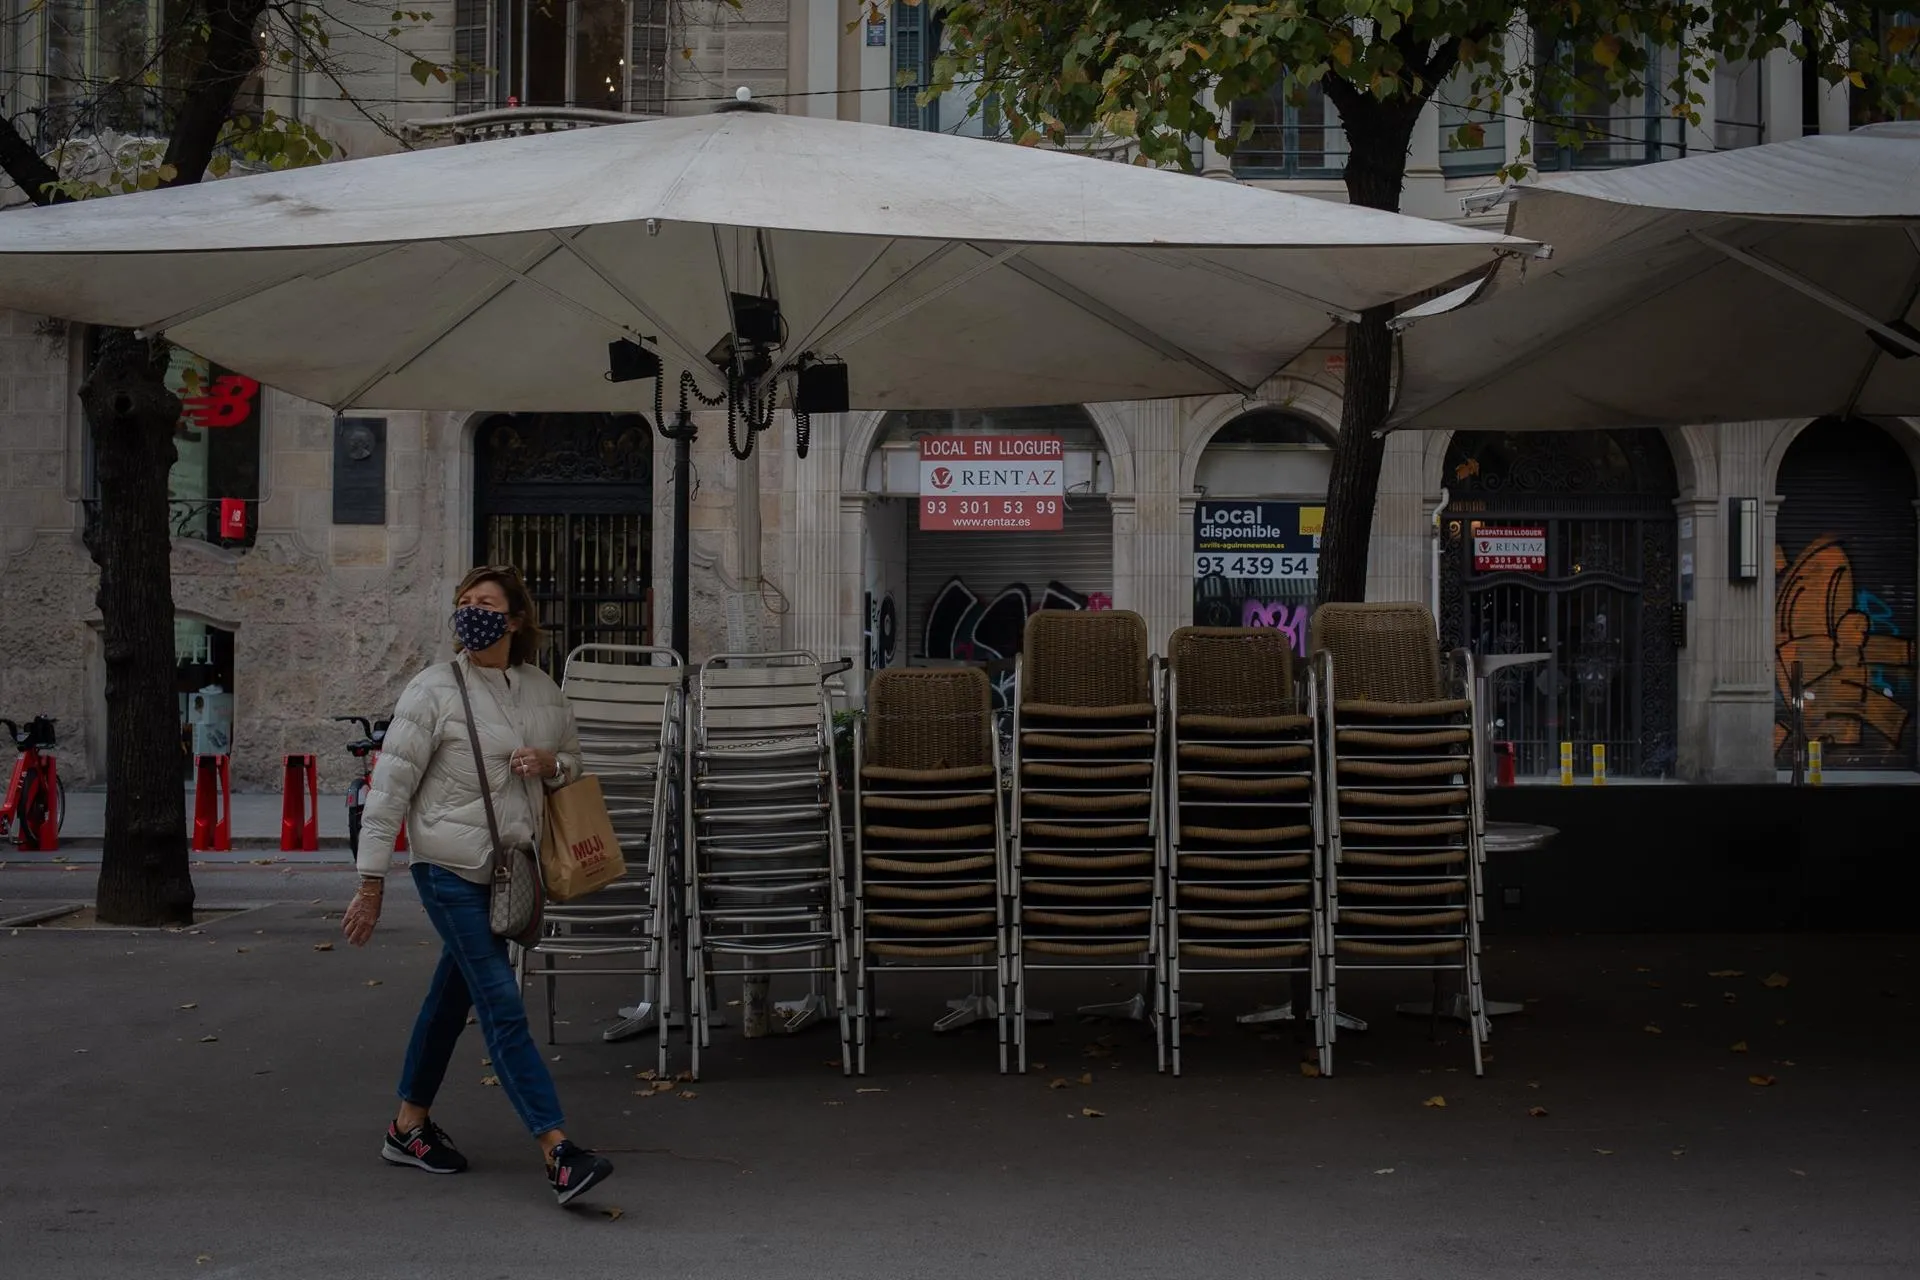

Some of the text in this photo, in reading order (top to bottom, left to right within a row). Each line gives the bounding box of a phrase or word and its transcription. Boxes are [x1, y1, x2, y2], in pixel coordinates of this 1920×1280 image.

[924, 440, 1060, 456] LOCAL EN LLOGUER
[962, 470, 1056, 486] RENTAZ
[927, 501, 1056, 514] 93 301 53 99
[1201, 505, 1263, 524] Local
[953, 517, 1031, 527] www.rentaz.es
[1200, 525, 1281, 540] disponible
[1495, 543, 1543, 552] RENTAZ
[1197, 557, 1309, 575] 93 439 54
[571, 833, 604, 861] MUJI
